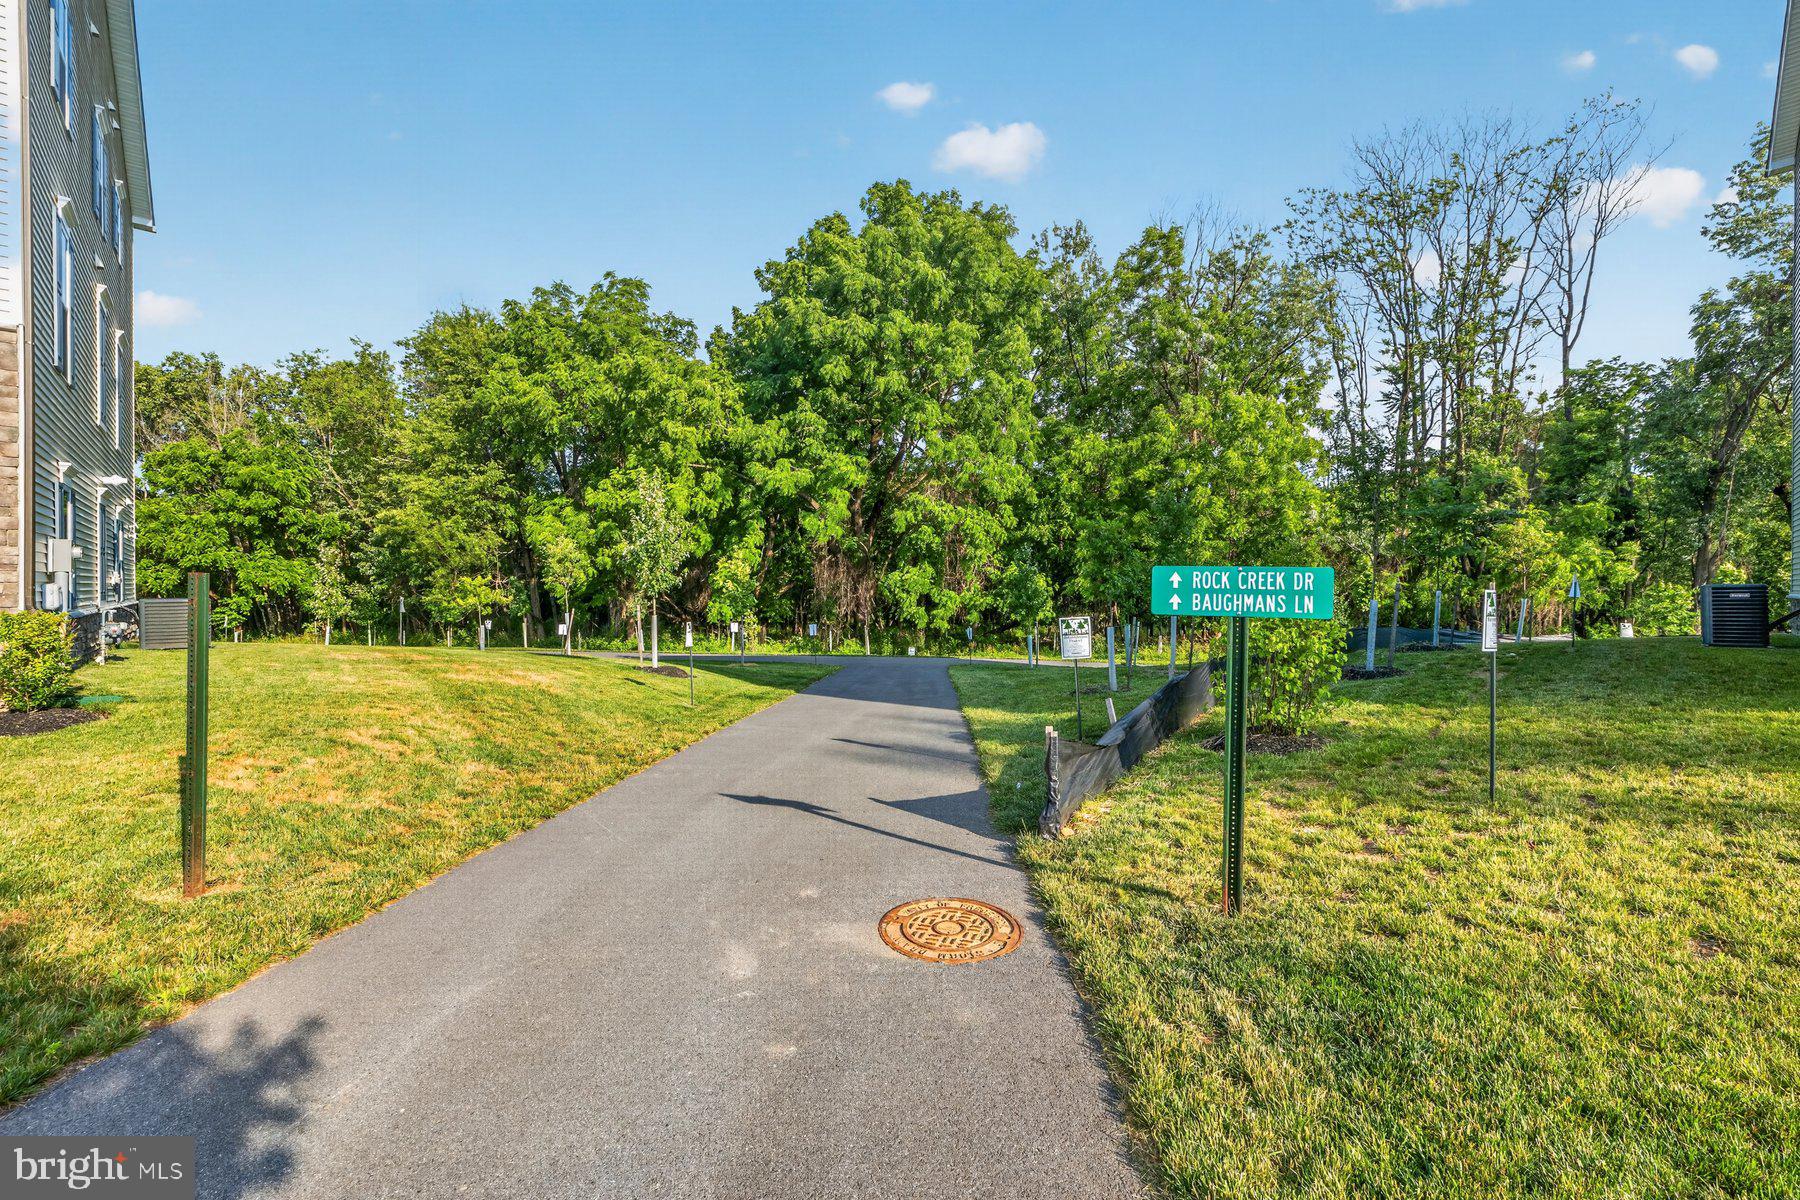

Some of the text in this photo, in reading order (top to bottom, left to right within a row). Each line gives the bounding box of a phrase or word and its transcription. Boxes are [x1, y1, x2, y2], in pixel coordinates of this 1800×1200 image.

[1192, 571, 1314, 591] ROCK CREEK DR
[1192, 593, 1314, 614] BAUGHMANS LN
